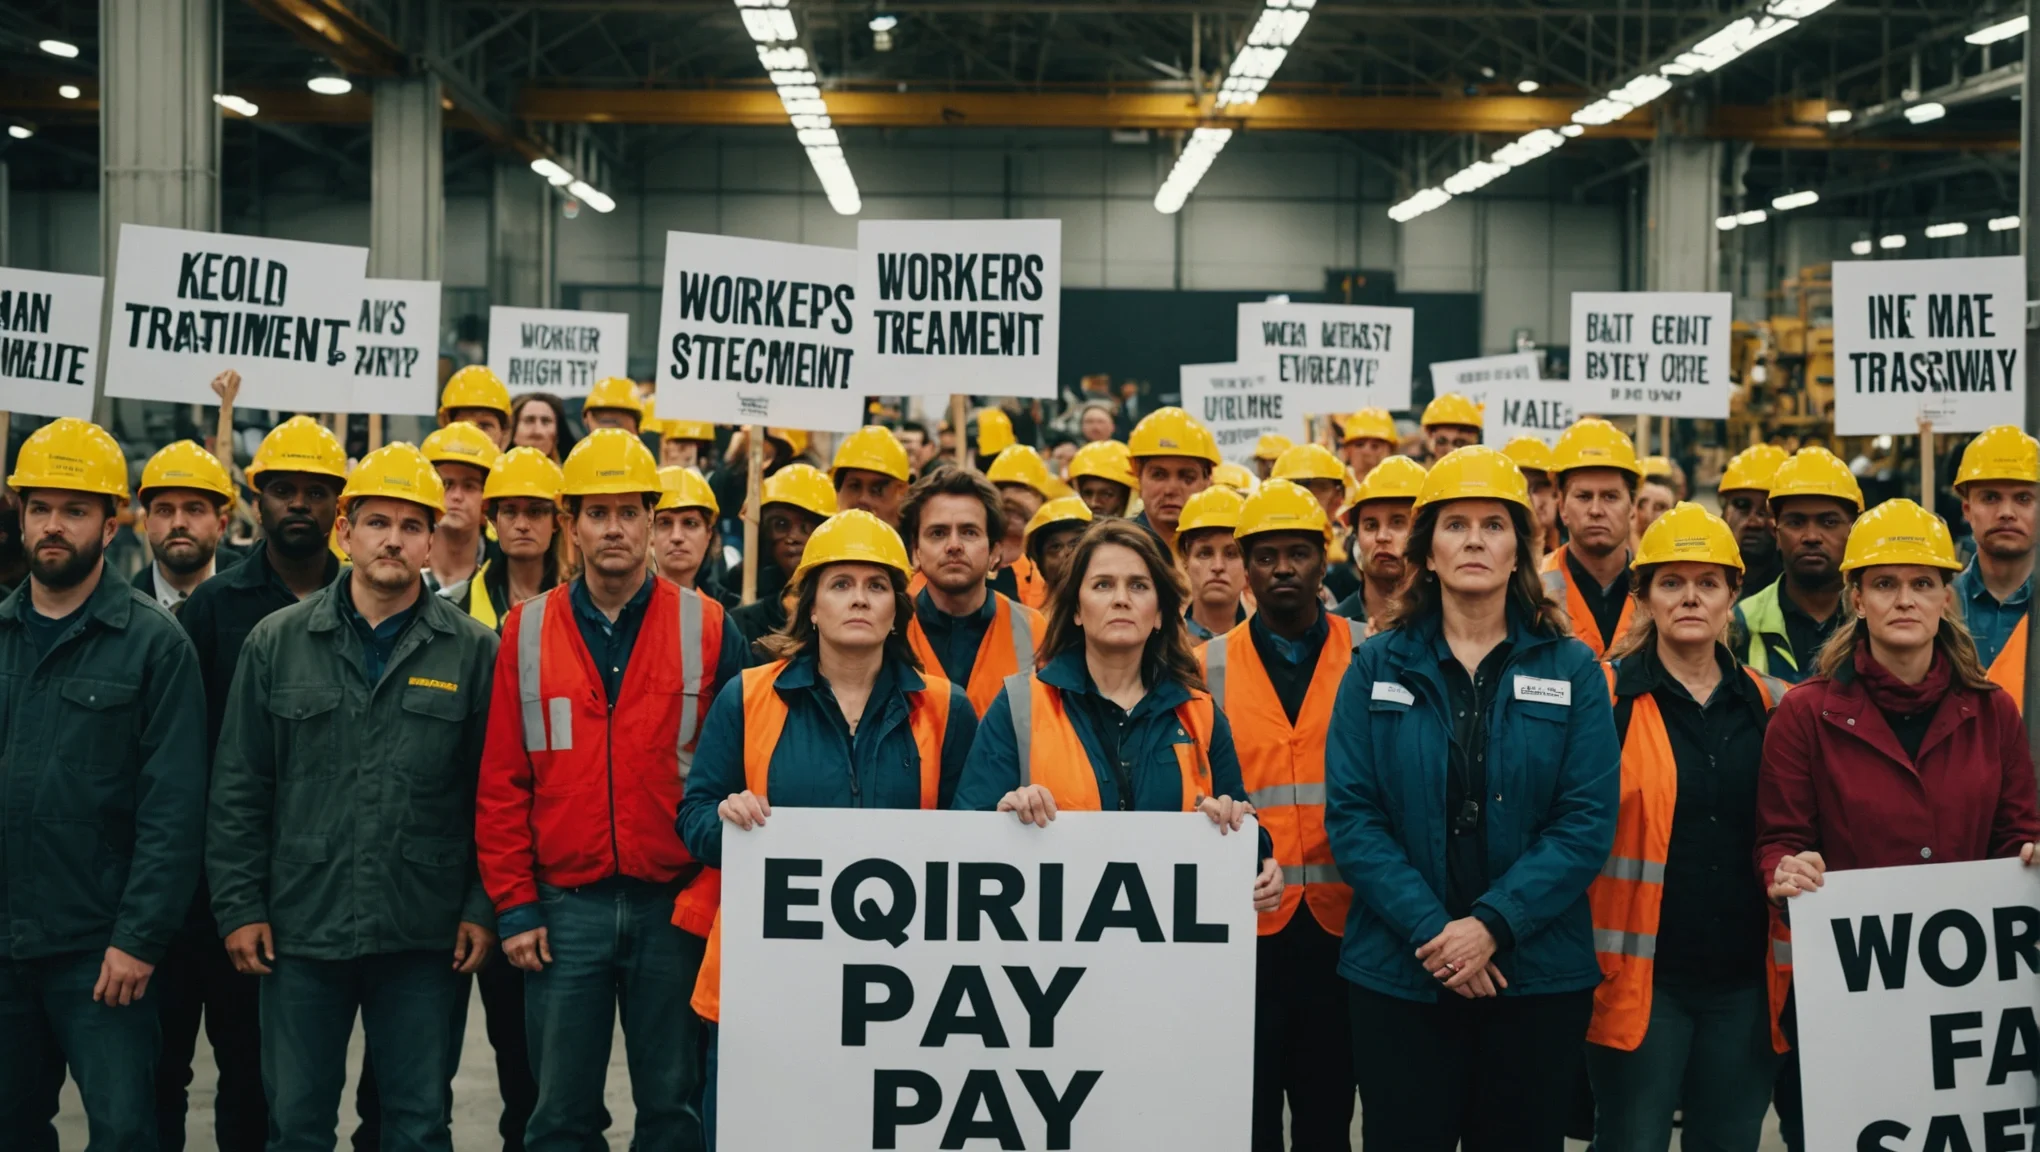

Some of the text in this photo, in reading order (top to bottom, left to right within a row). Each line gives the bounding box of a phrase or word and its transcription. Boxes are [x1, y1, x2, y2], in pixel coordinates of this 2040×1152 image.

[877, 253, 1044, 302] WORKERS
[763, 857, 1229, 949] EQIRIAL
[1830, 905, 2040, 993] WOR
[841, 963, 1087, 1048] PAY
[872, 1068, 1104, 1151] PAY
